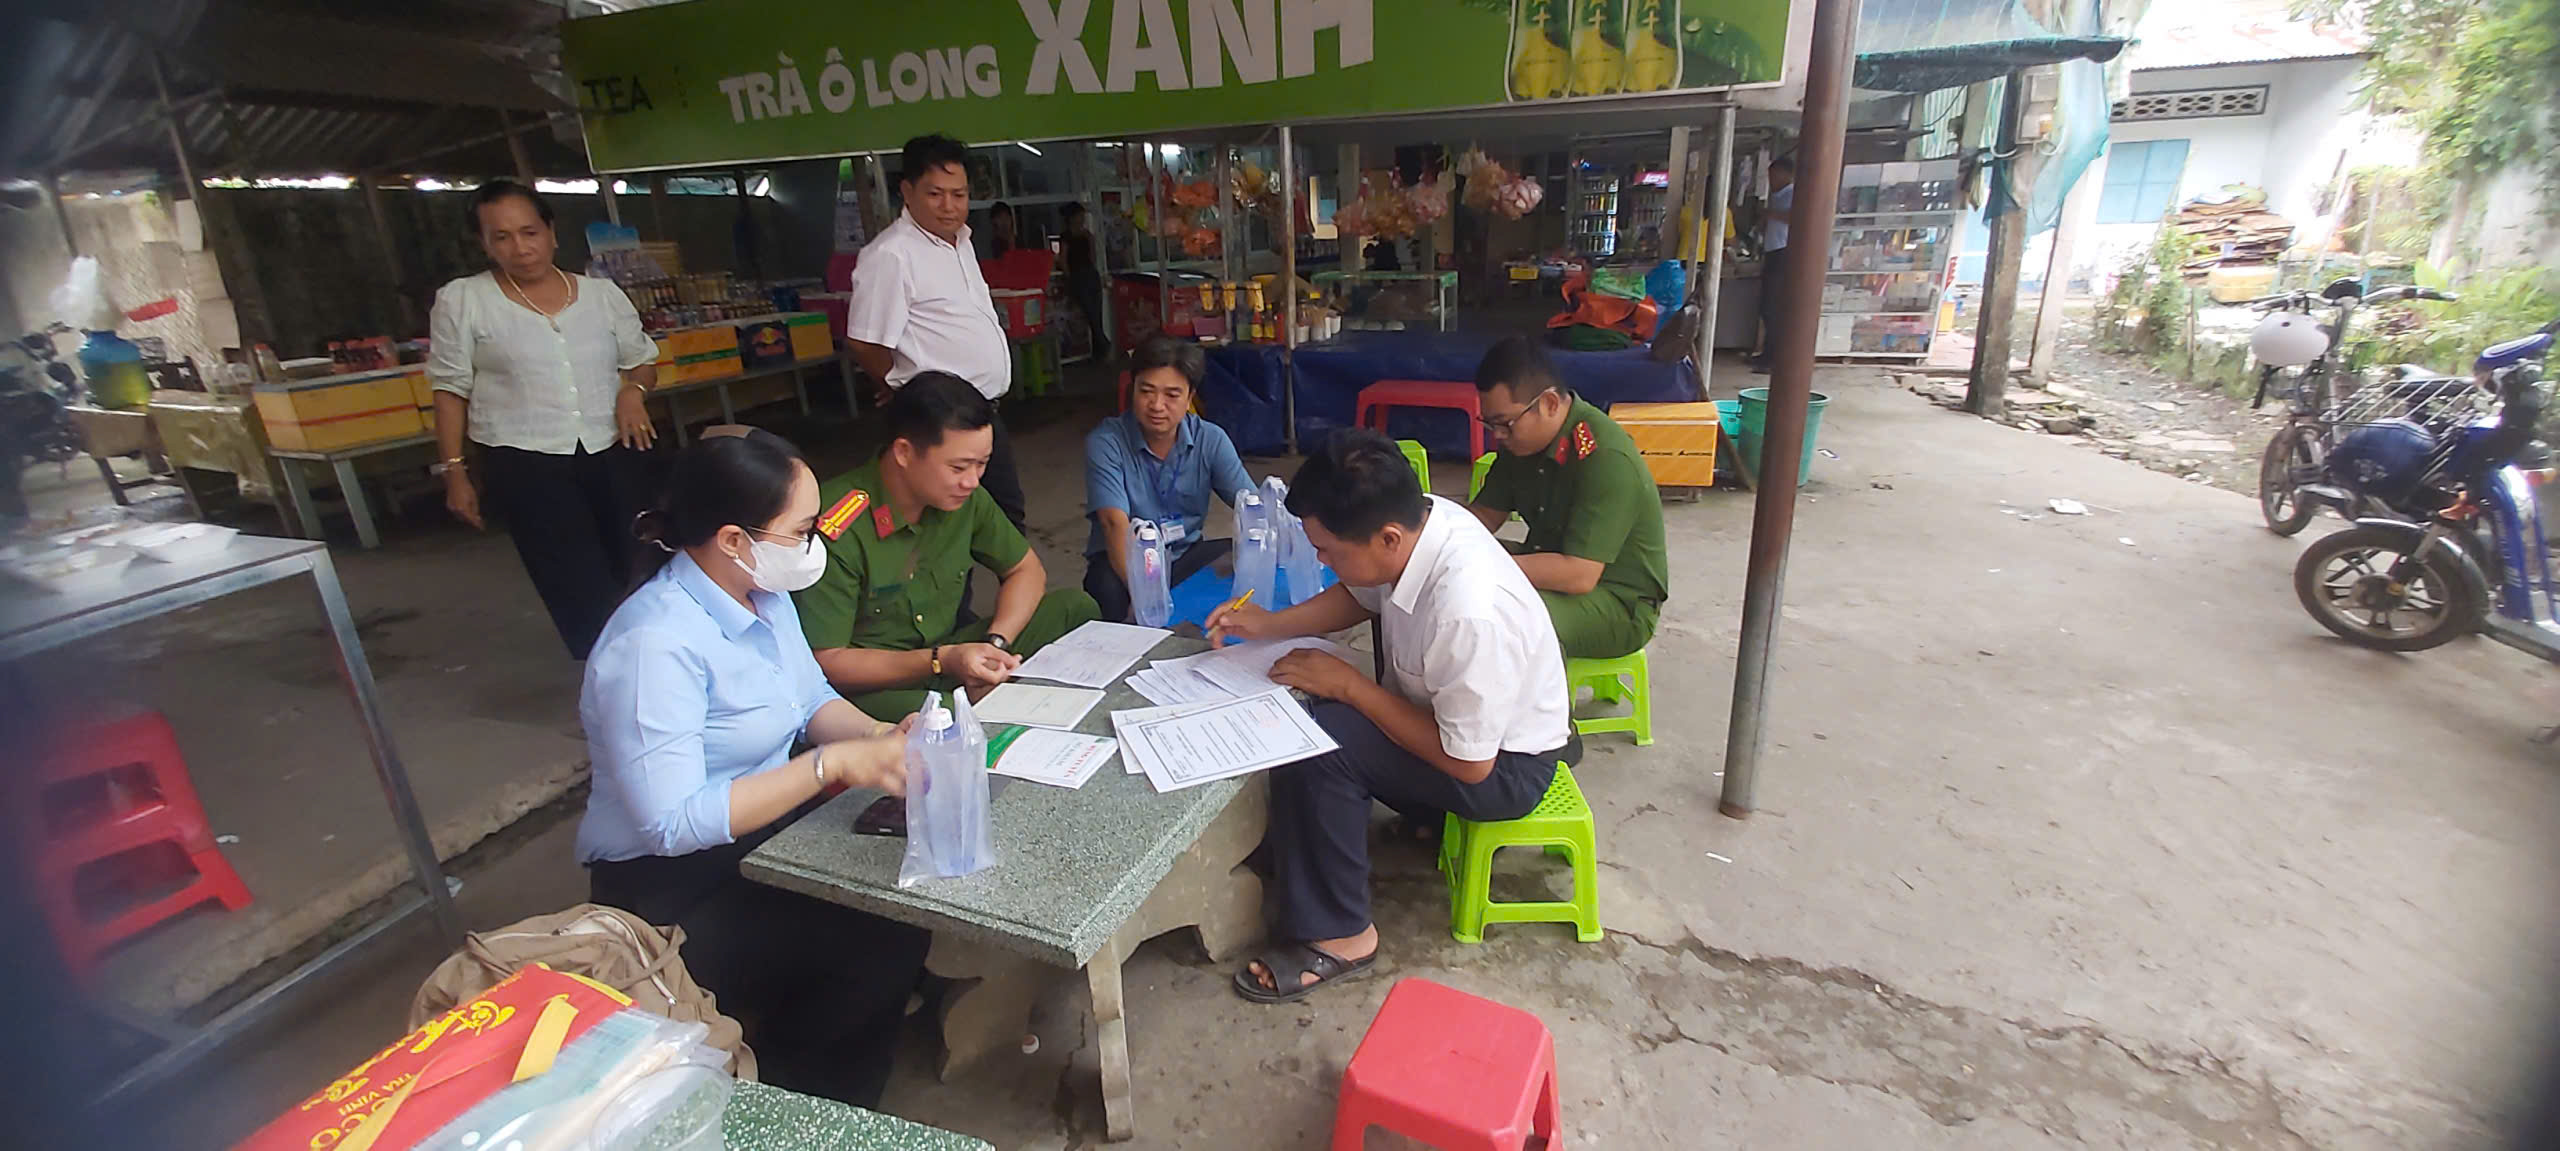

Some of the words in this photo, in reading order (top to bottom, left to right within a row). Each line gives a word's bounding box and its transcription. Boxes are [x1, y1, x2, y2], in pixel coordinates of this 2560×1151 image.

[718, 49, 814, 125] TRÀ
[818, 46, 856, 114] Ô
[861, 43, 1002, 109] LONG
[1017, 0, 1374, 95] XANH
[582, 74, 653, 112] TEA
[338, 1090, 381, 1117] VINH
